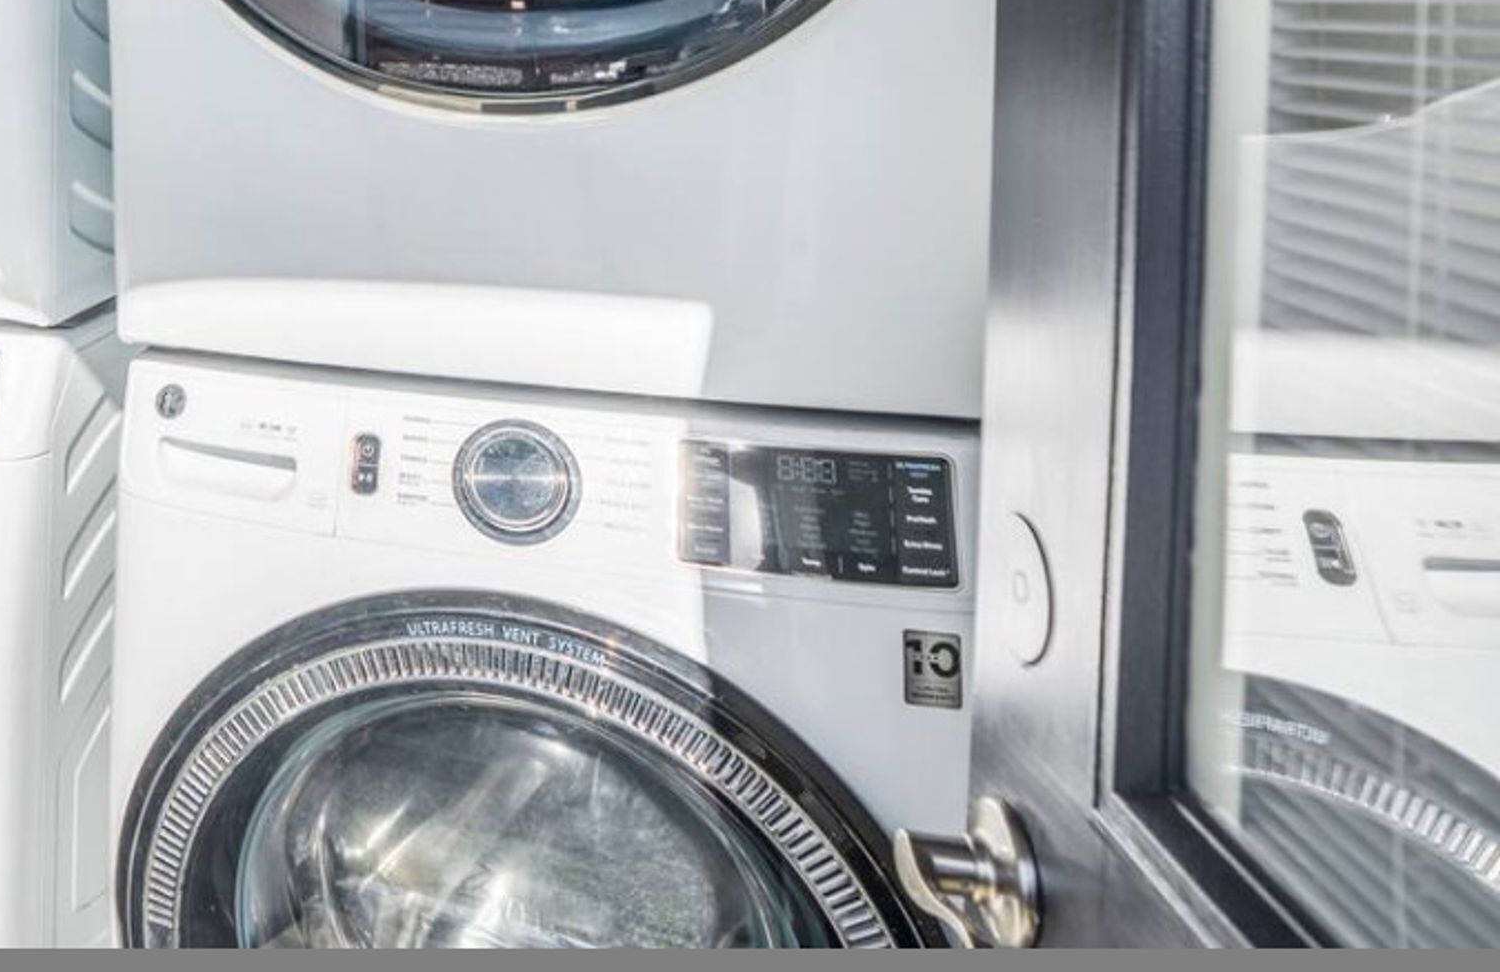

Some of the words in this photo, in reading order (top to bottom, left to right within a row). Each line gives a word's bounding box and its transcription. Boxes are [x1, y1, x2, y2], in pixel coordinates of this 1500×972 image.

[406, 620, 494, 638] ULTRAFRESH
[502, 625, 539, 647] VENT
[549, 636, 607, 664] SYSTEM
